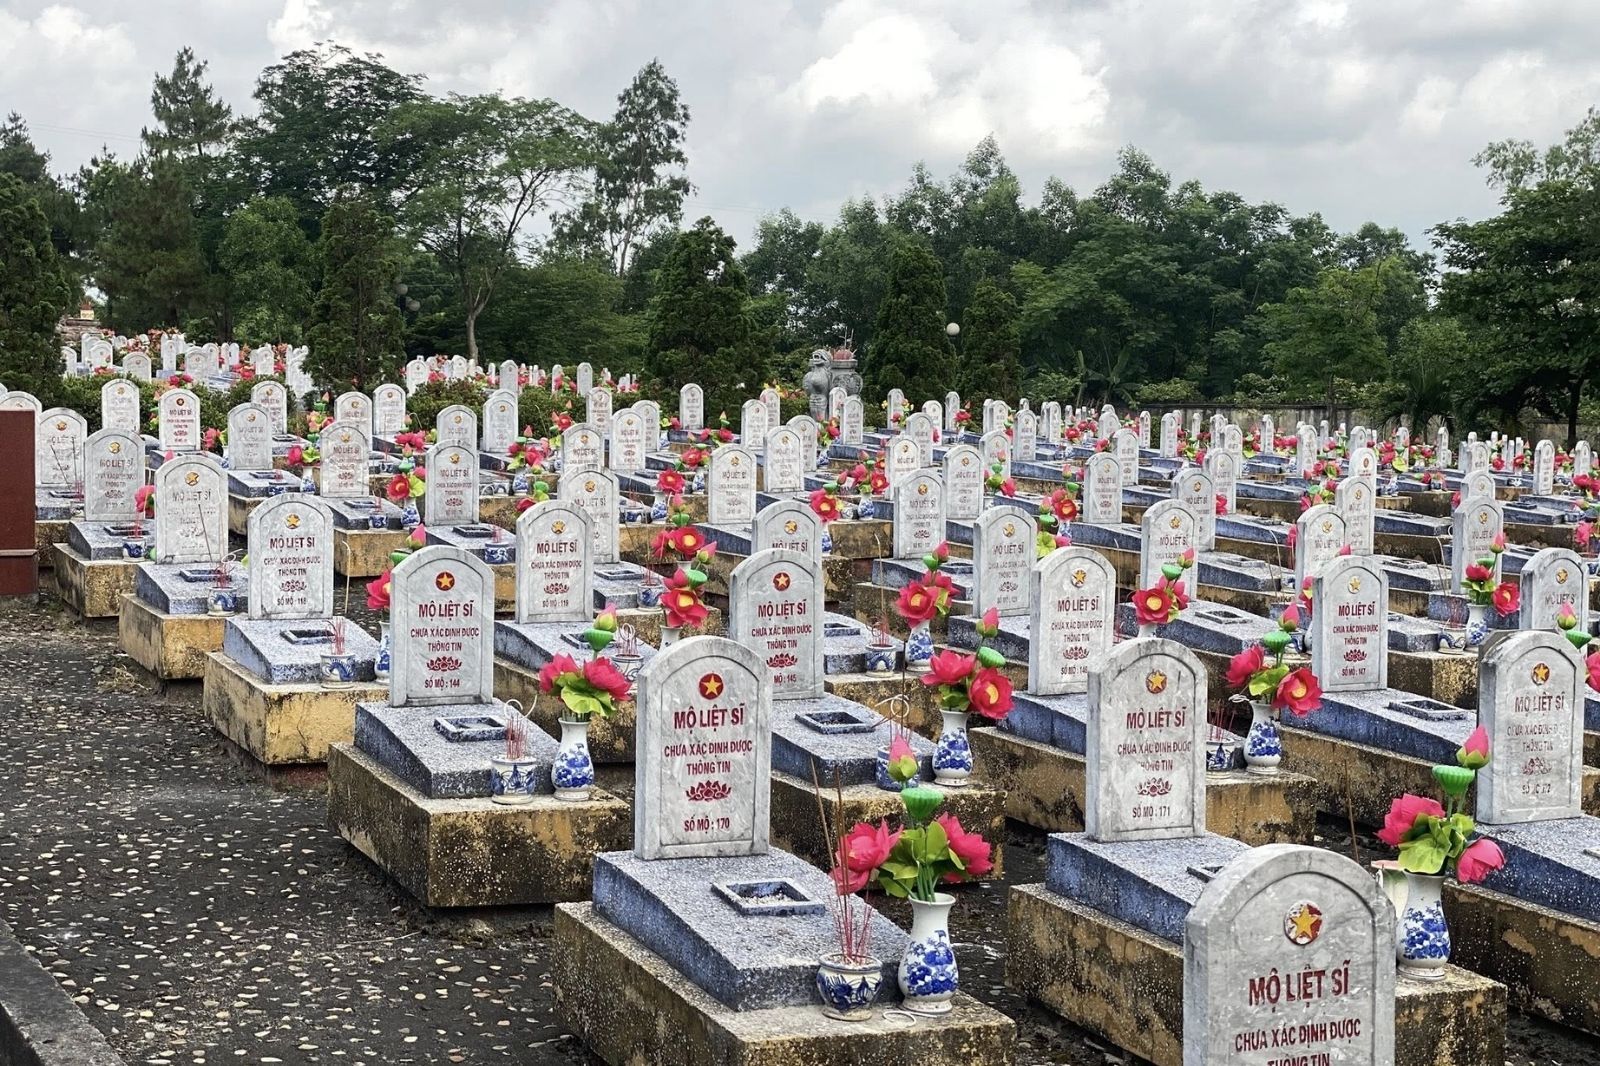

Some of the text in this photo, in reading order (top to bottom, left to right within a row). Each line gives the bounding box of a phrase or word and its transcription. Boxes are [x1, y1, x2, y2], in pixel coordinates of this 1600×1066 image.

[270, 534, 315, 552] MỘ LIỆT SĨ
[536, 539, 578, 556] MỘ LIỆT SĨ
[418, 600, 474, 622] MỘ LIỆT SĨ
[758, 599, 807, 620] MỘ LIỆT SĨ
[1058, 596, 1100, 616] MỘ LIỆT SĨ
[1338, 601, 1376, 620] MỘ LIỆT SĨ
[410, 626, 480, 640] CHƯA XÁC ĐỊNH ĐƯỢC
[752, 627, 768, 637] CHƯA
[769, 624, 780, 636] XÁC
[428, 640, 462, 652] THÔNG TIN
[767, 638, 798, 650] THÔNG TIN
[424, 675, 432, 688] SỐ
[434, 676, 444, 691] MỘ
[450, 679, 460, 688] 144
[787, 674, 796, 682] 145
[674, 703, 745, 734] MỘ LIỆT SĨ
[1126, 706, 1186, 734] MỘ LIỆT SĨ
[664, 740, 752, 758] CHƯA XÁC ĐỊNH ĐƯỢC
[687, 760, 730, 775] THÔNG TIN
[1161, 760, 1173, 770] TIN
[1160, 806, 1170, 816] 171
[684, 814, 695, 832] SỐ
[697, 816, 710, 834] MỘ
[716, 818, 730, 829] 170
[1249, 960, 1351, 1013] MỘ LIỆT SĨ
[1235, 1018, 1360, 1052] CHƯA XÁC ĐỊNH ĐƯỢC
